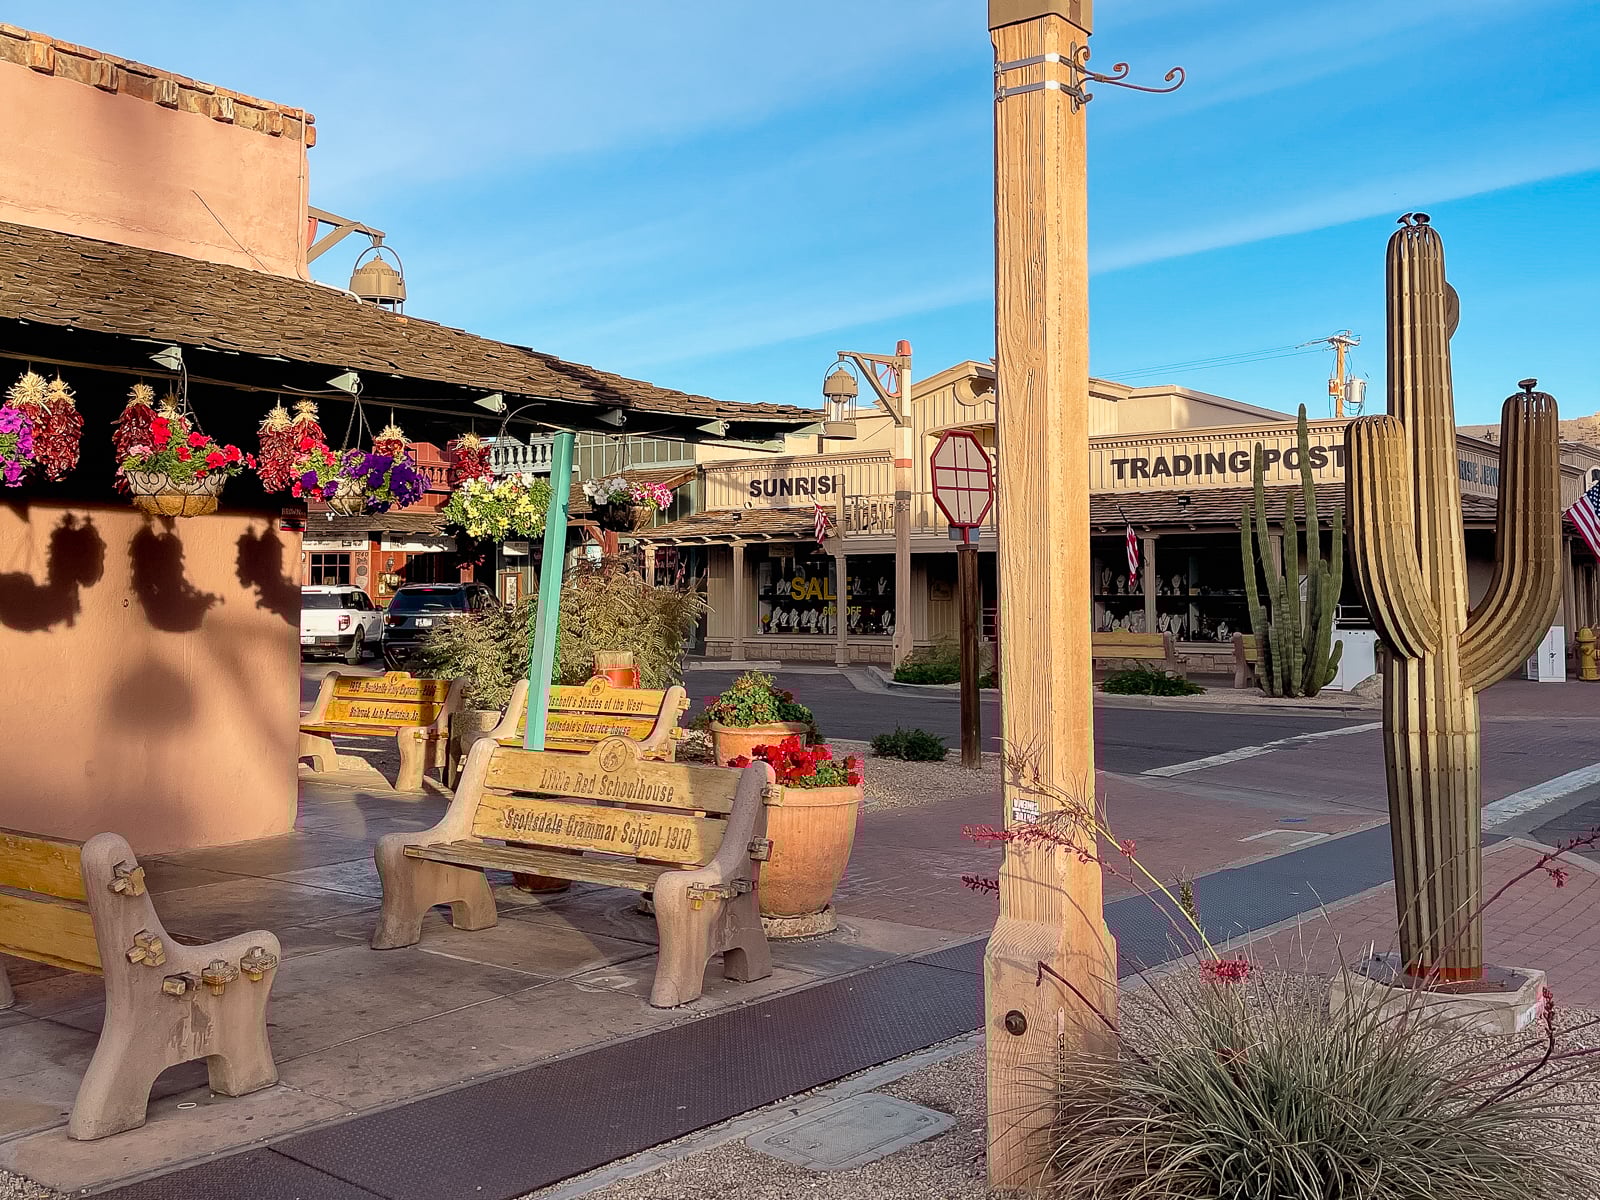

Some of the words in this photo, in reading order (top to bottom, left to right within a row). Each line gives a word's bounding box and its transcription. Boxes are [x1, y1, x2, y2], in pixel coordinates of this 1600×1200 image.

[1110, 450, 1252, 480] TRADING
[1263, 445, 1345, 472] POST
[547, 695, 577, 708] ischoff's
[579, 696, 602, 709] Shades
[604, 697, 612, 710] of
[612, 698, 624, 711] the
[626, 698, 643, 712] West
[546, 719, 582, 733] cottsdale's
[582, 720, 597, 734] first
[610, 723, 631, 737] house
[539, 768, 571, 792] Little
[573, 773, 597, 795] Red
[599, 774, 675, 803] Schoolhouse
[505, 807, 563, 834] Scottsdale
[566, 816, 618, 842] Grammar
[621, 822, 662, 847] School
